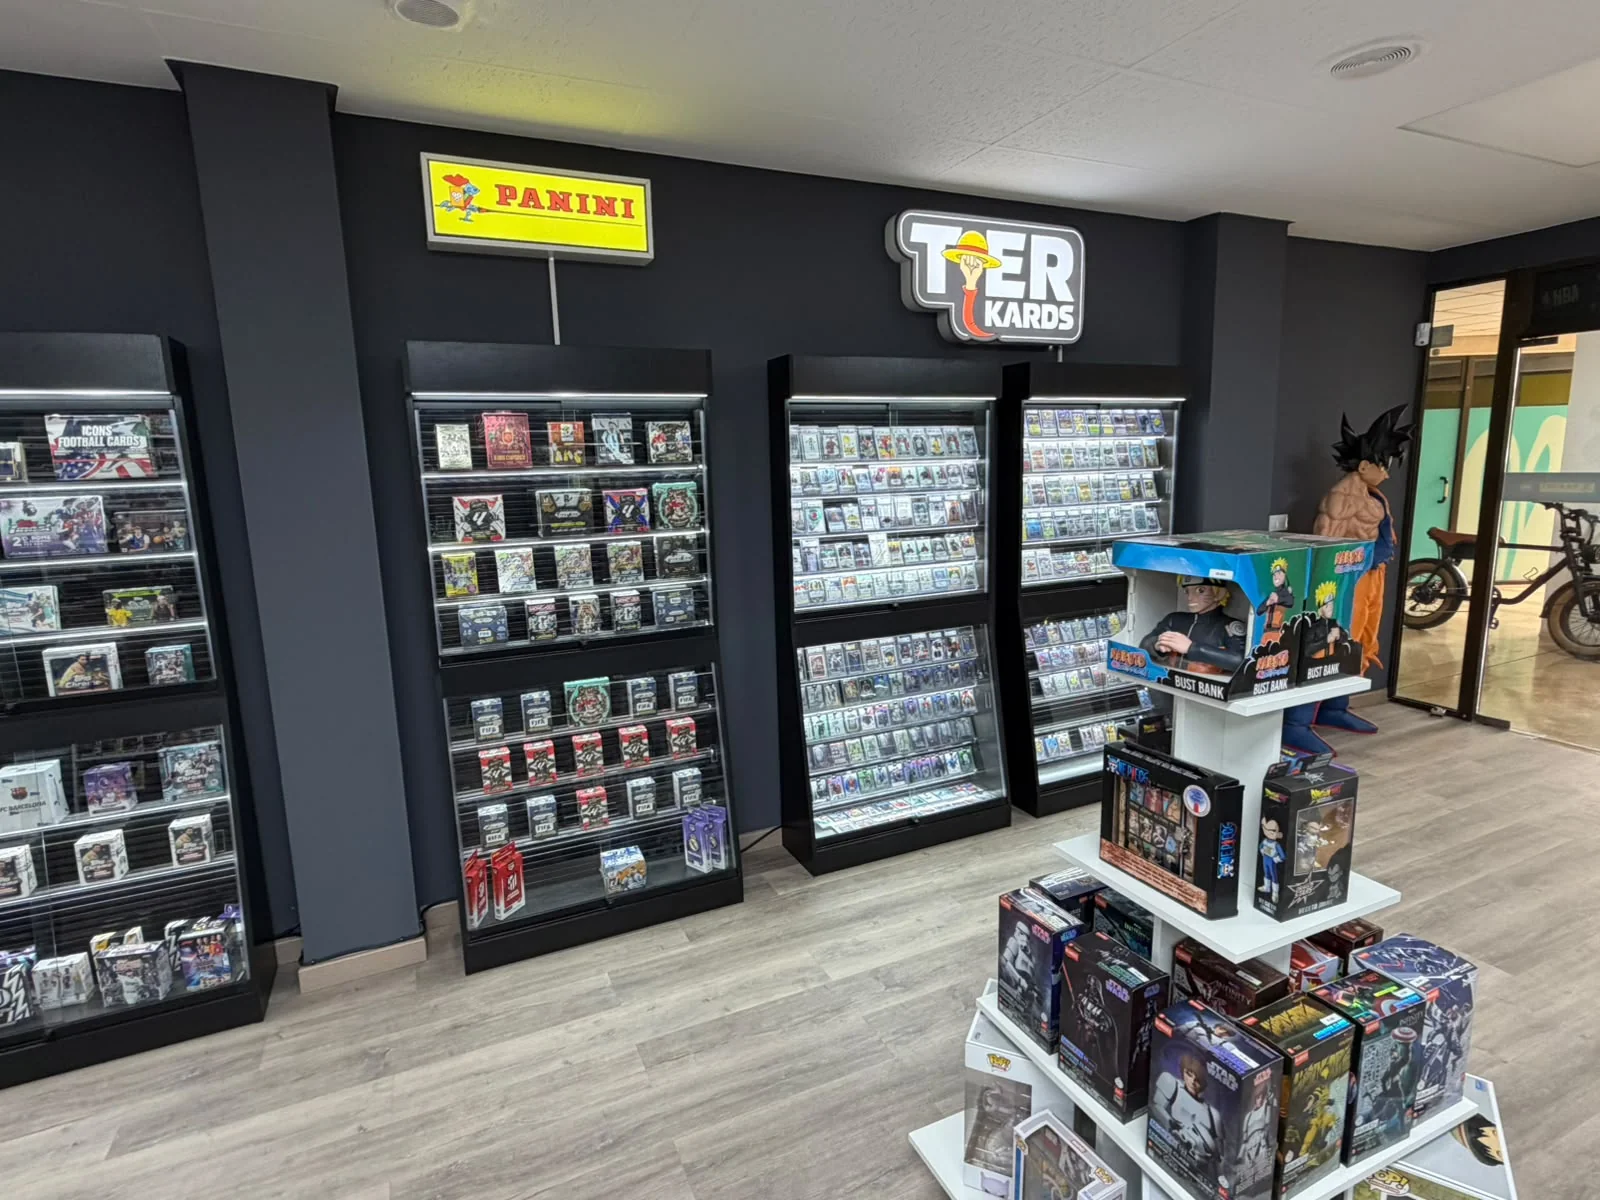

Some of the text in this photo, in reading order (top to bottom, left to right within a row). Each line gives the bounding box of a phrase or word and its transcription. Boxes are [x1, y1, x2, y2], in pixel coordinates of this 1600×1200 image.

[495, 184, 635, 219] PANINI
[984, 300, 1074, 330] KARDS
[58, 435, 140, 448] FOOTBALL CARDS
[81, 425, 113, 436] ICONS
[1307, 663, 1340, 679] BUST BANK
[1174, 675, 1224, 700] BUST BANK
[1253, 678, 1288, 695] BUST BANK
[1206, 1061, 1236, 1083] STAR
[1206, 1068, 1238, 1091] WARS
